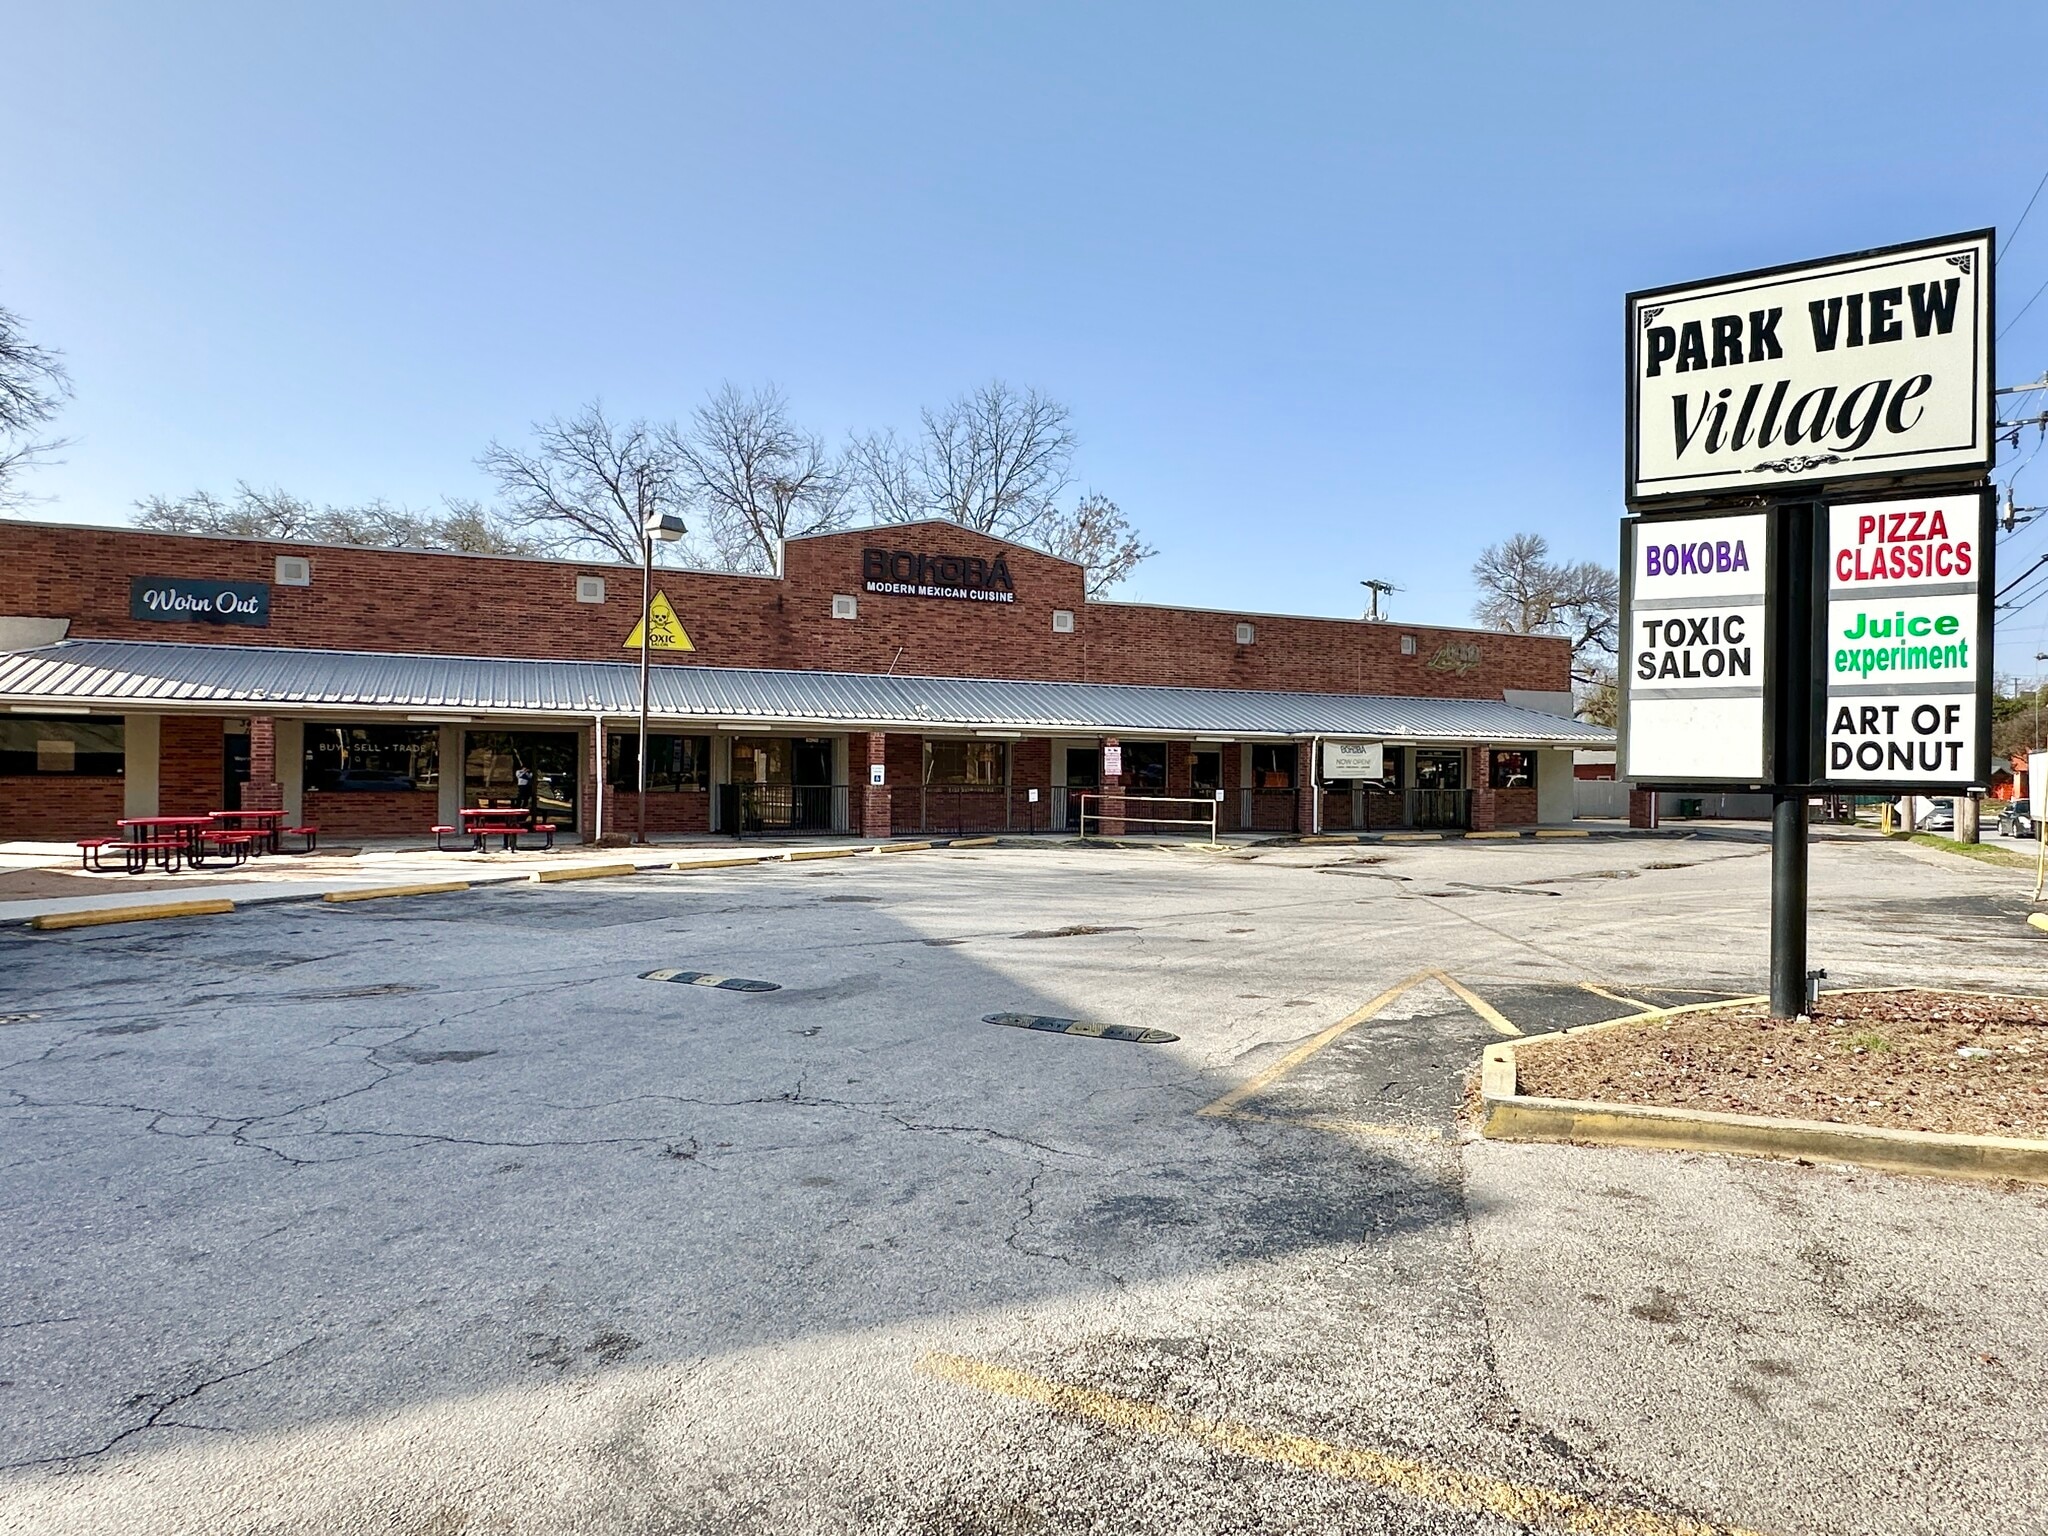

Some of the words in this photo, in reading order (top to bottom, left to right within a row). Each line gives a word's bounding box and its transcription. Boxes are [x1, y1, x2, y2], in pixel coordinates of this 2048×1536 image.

[1646, 307, 1783, 378] PARK
[1808, 277, 1962, 353] VIEW
[1672, 373, 1934, 460] Village
[1858, 509, 1949, 546] PIZZA
[1646, 539, 1749, 578] BOKOBA
[1836, 541, 1972, 582] CLASSICS
[143, 588, 212, 612] Worn
[216, 591, 259, 614] Out
[866, 581, 916, 595] MODERN
[918, 585, 967, 599] MEXICAN
[970, 589, 1014, 603] CUISINE
[649, 635, 675, 643] OXIC
[1642, 614, 1746, 649] TOXIC
[1843, 611, 1960, 641] Juice
[1637, 646, 1751, 681] SALON
[1835, 636, 1969, 679] experiment
[1832, 705, 1900, 736] ART
[1911, 703, 1962, 736] OF
[319, 743, 341, 751] BUY
[353, 743, 381, 752] SELL
[392, 744, 426, 753] TRADE
[1831, 740, 1964, 772] DONUT
